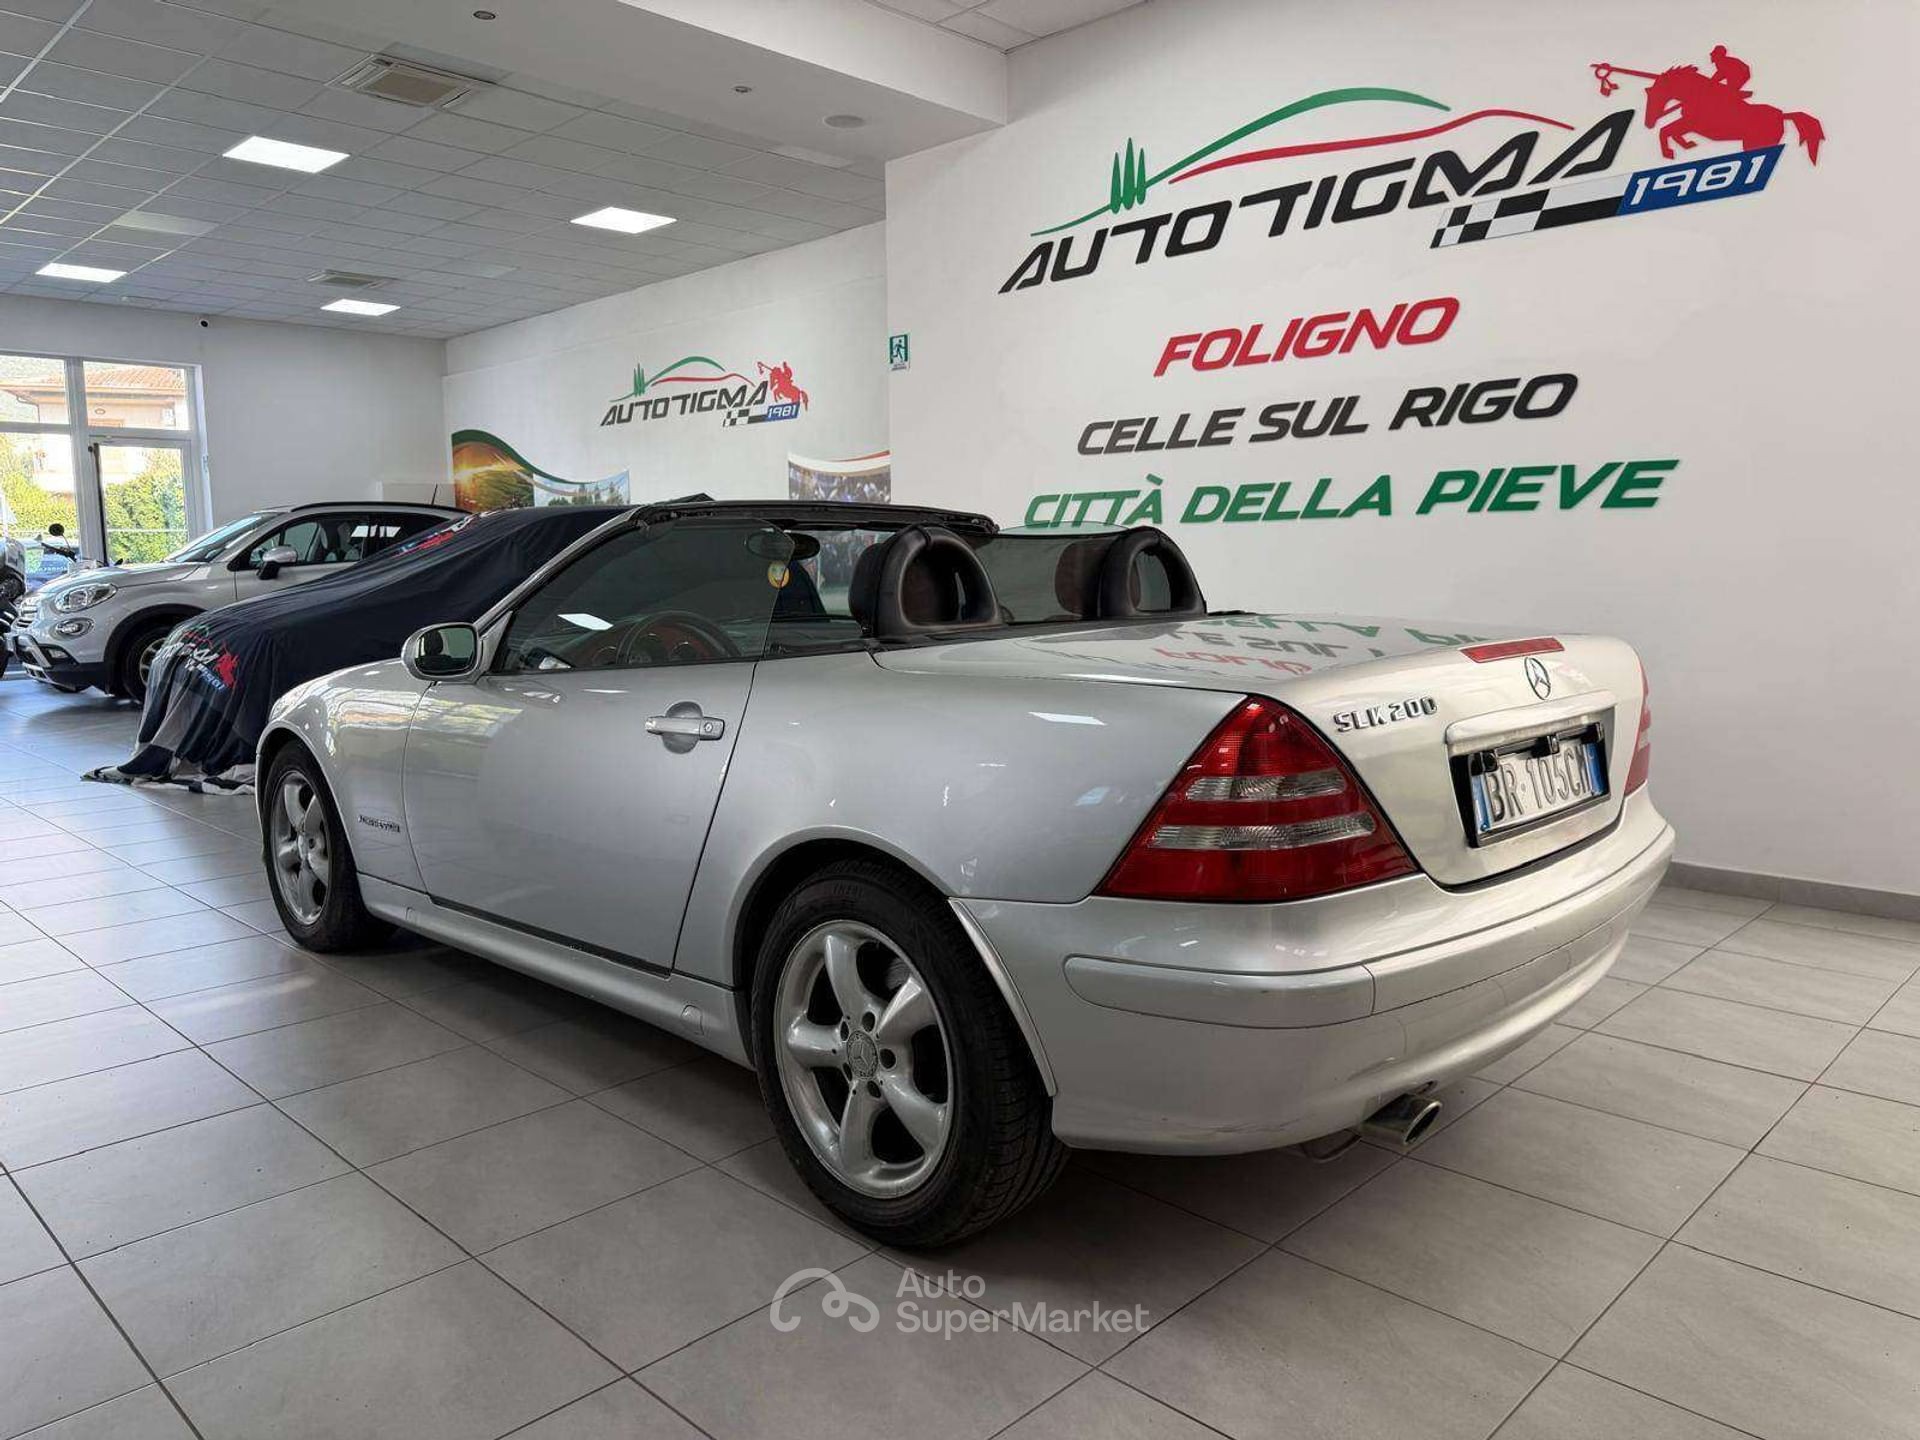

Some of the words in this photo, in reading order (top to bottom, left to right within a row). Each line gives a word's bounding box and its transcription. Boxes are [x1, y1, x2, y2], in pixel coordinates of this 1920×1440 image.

[1630, 154, 1767, 206] 1981
[1154, 296, 1460, 376] FOLIGNO
[600, 380, 768, 427] AUTOTIGMA
[767, 405, 798, 419] 1981
[1077, 408, 1246, 455] CELLE
[1248, 395, 1369, 443] SUL
[1389, 374, 1578, 430] RIGO
[1025, 475, 1162, 529] CITTÀ
[1180, 474, 1393, 525] DELLA
[1417, 459, 1680, 516] PIEVE
[1333, 706, 1388, 732] SLK
[1388, 696, 1438, 721] 200
[1484, 763, 1523, 822] BR
